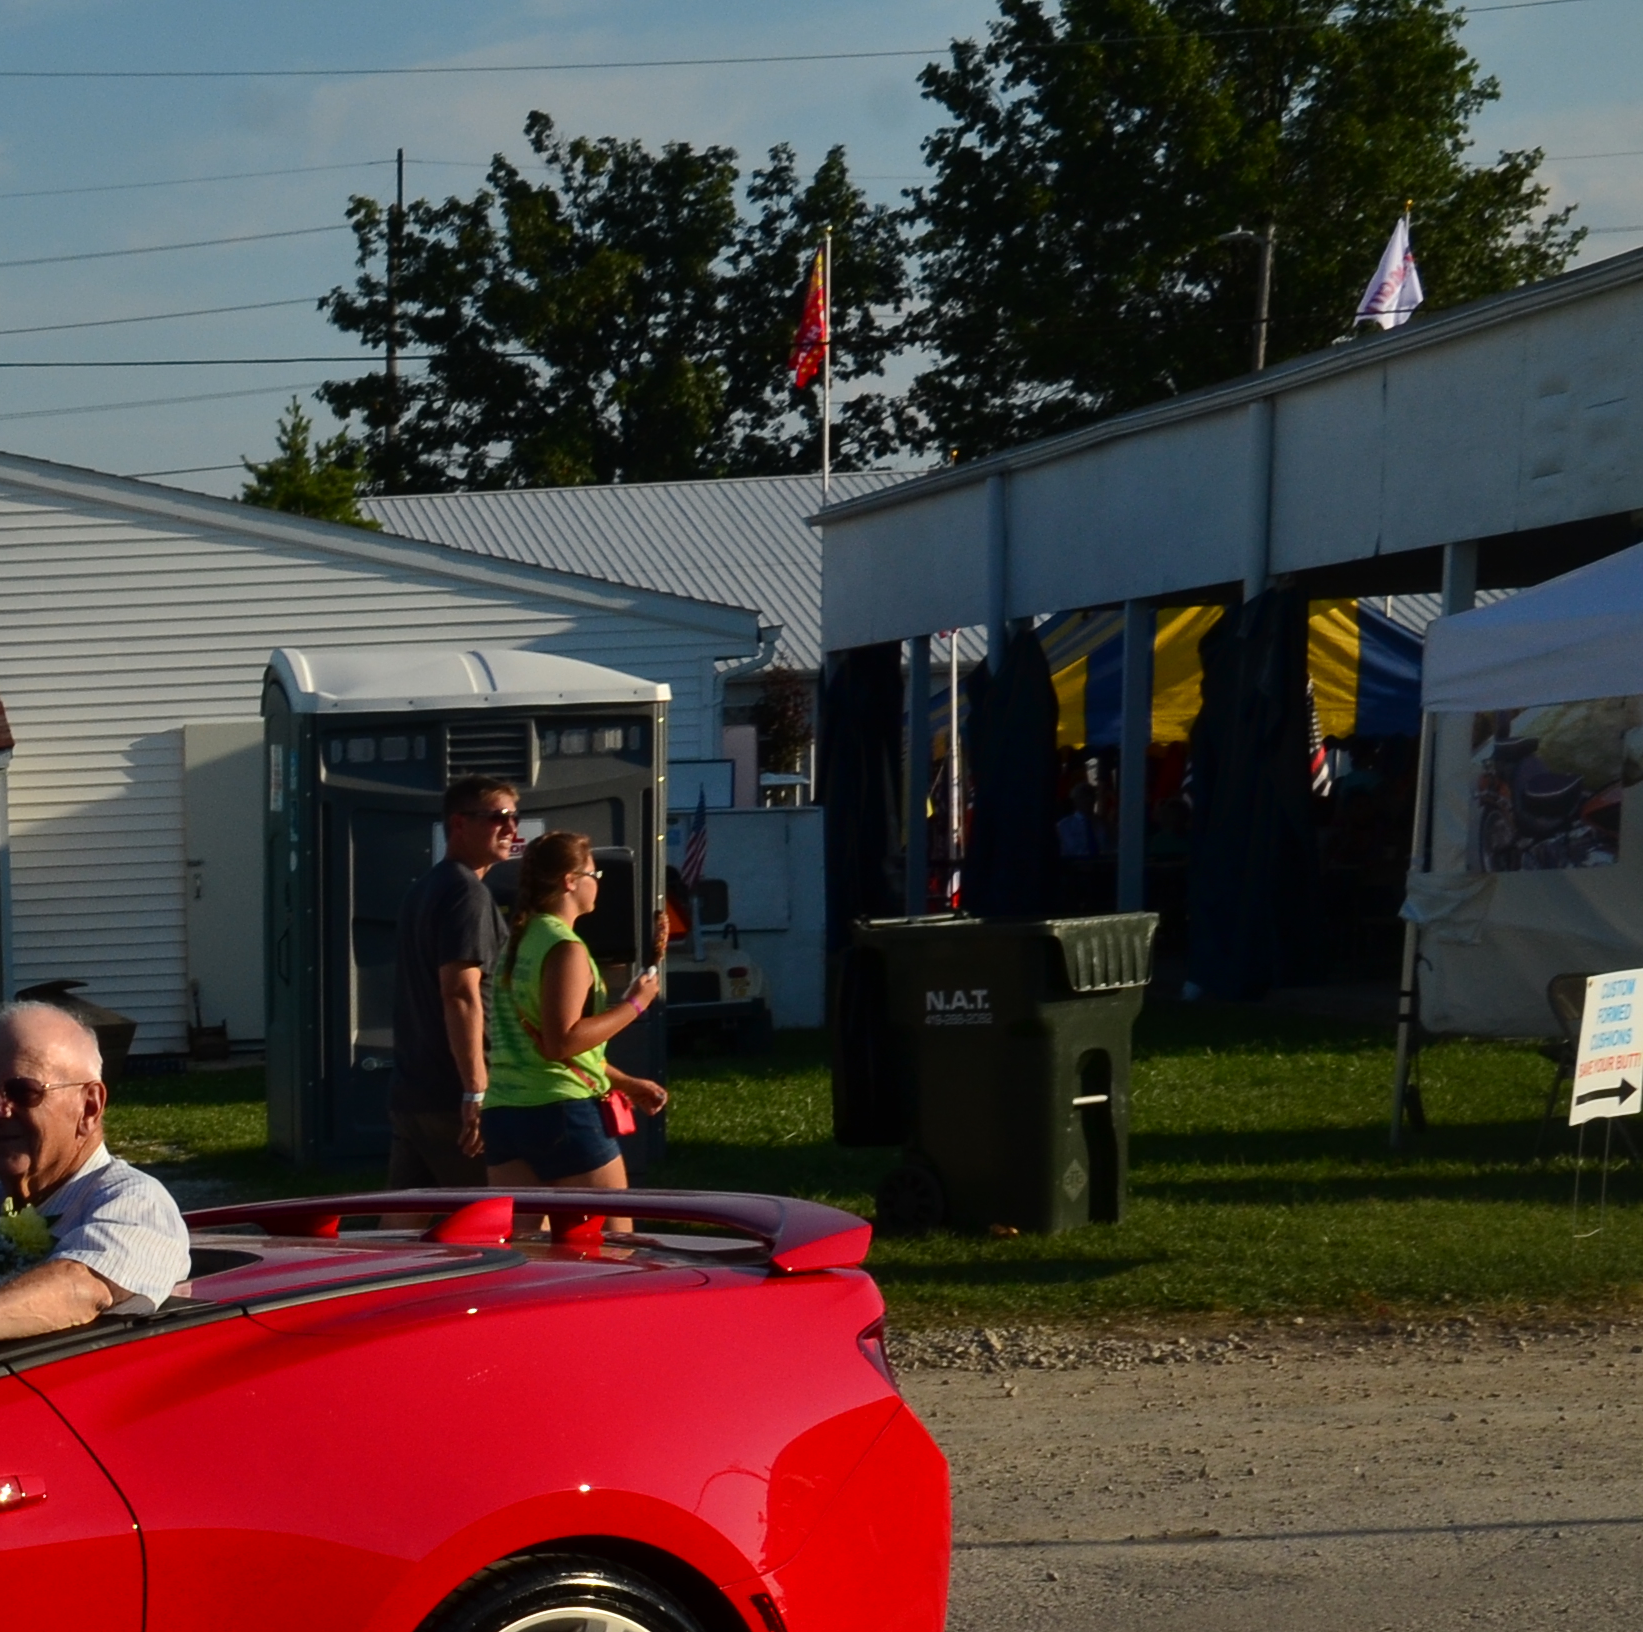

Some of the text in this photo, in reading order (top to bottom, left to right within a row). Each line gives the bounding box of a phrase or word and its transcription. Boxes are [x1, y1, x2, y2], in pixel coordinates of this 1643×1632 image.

[1602, 978, 1636, 999] CUSTOM
[925, 989, 990, 1011] N.A.T.
[1597, 1003, 1632, 1024] FORMED
[1590, 1028, 1633, 1051] CUSHIONS
[1616, 1052, 1641, 1071] BUTT!
